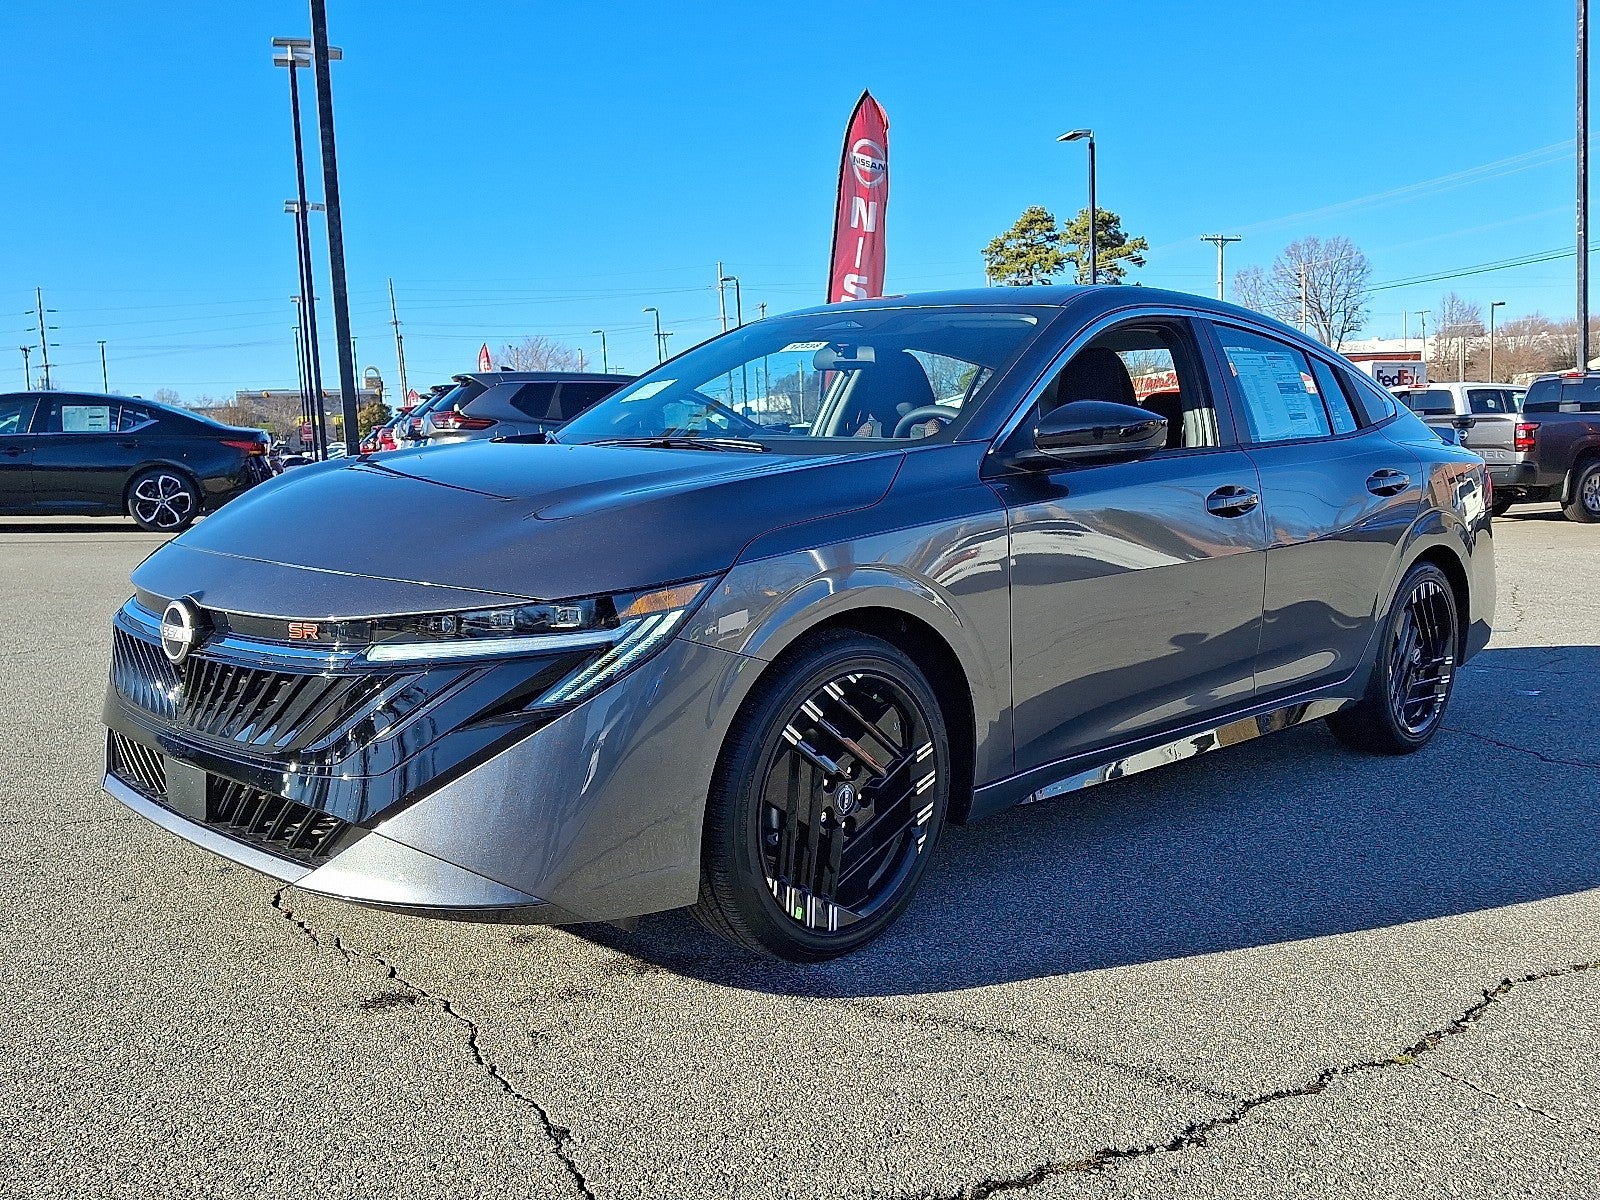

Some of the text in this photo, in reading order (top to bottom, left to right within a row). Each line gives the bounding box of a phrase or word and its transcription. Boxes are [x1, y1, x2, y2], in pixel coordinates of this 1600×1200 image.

[853, 155, 885, 170] NISSAN
[1377, 369, 1421, 387] FedEx
[288, 622, 320, 640] SR
